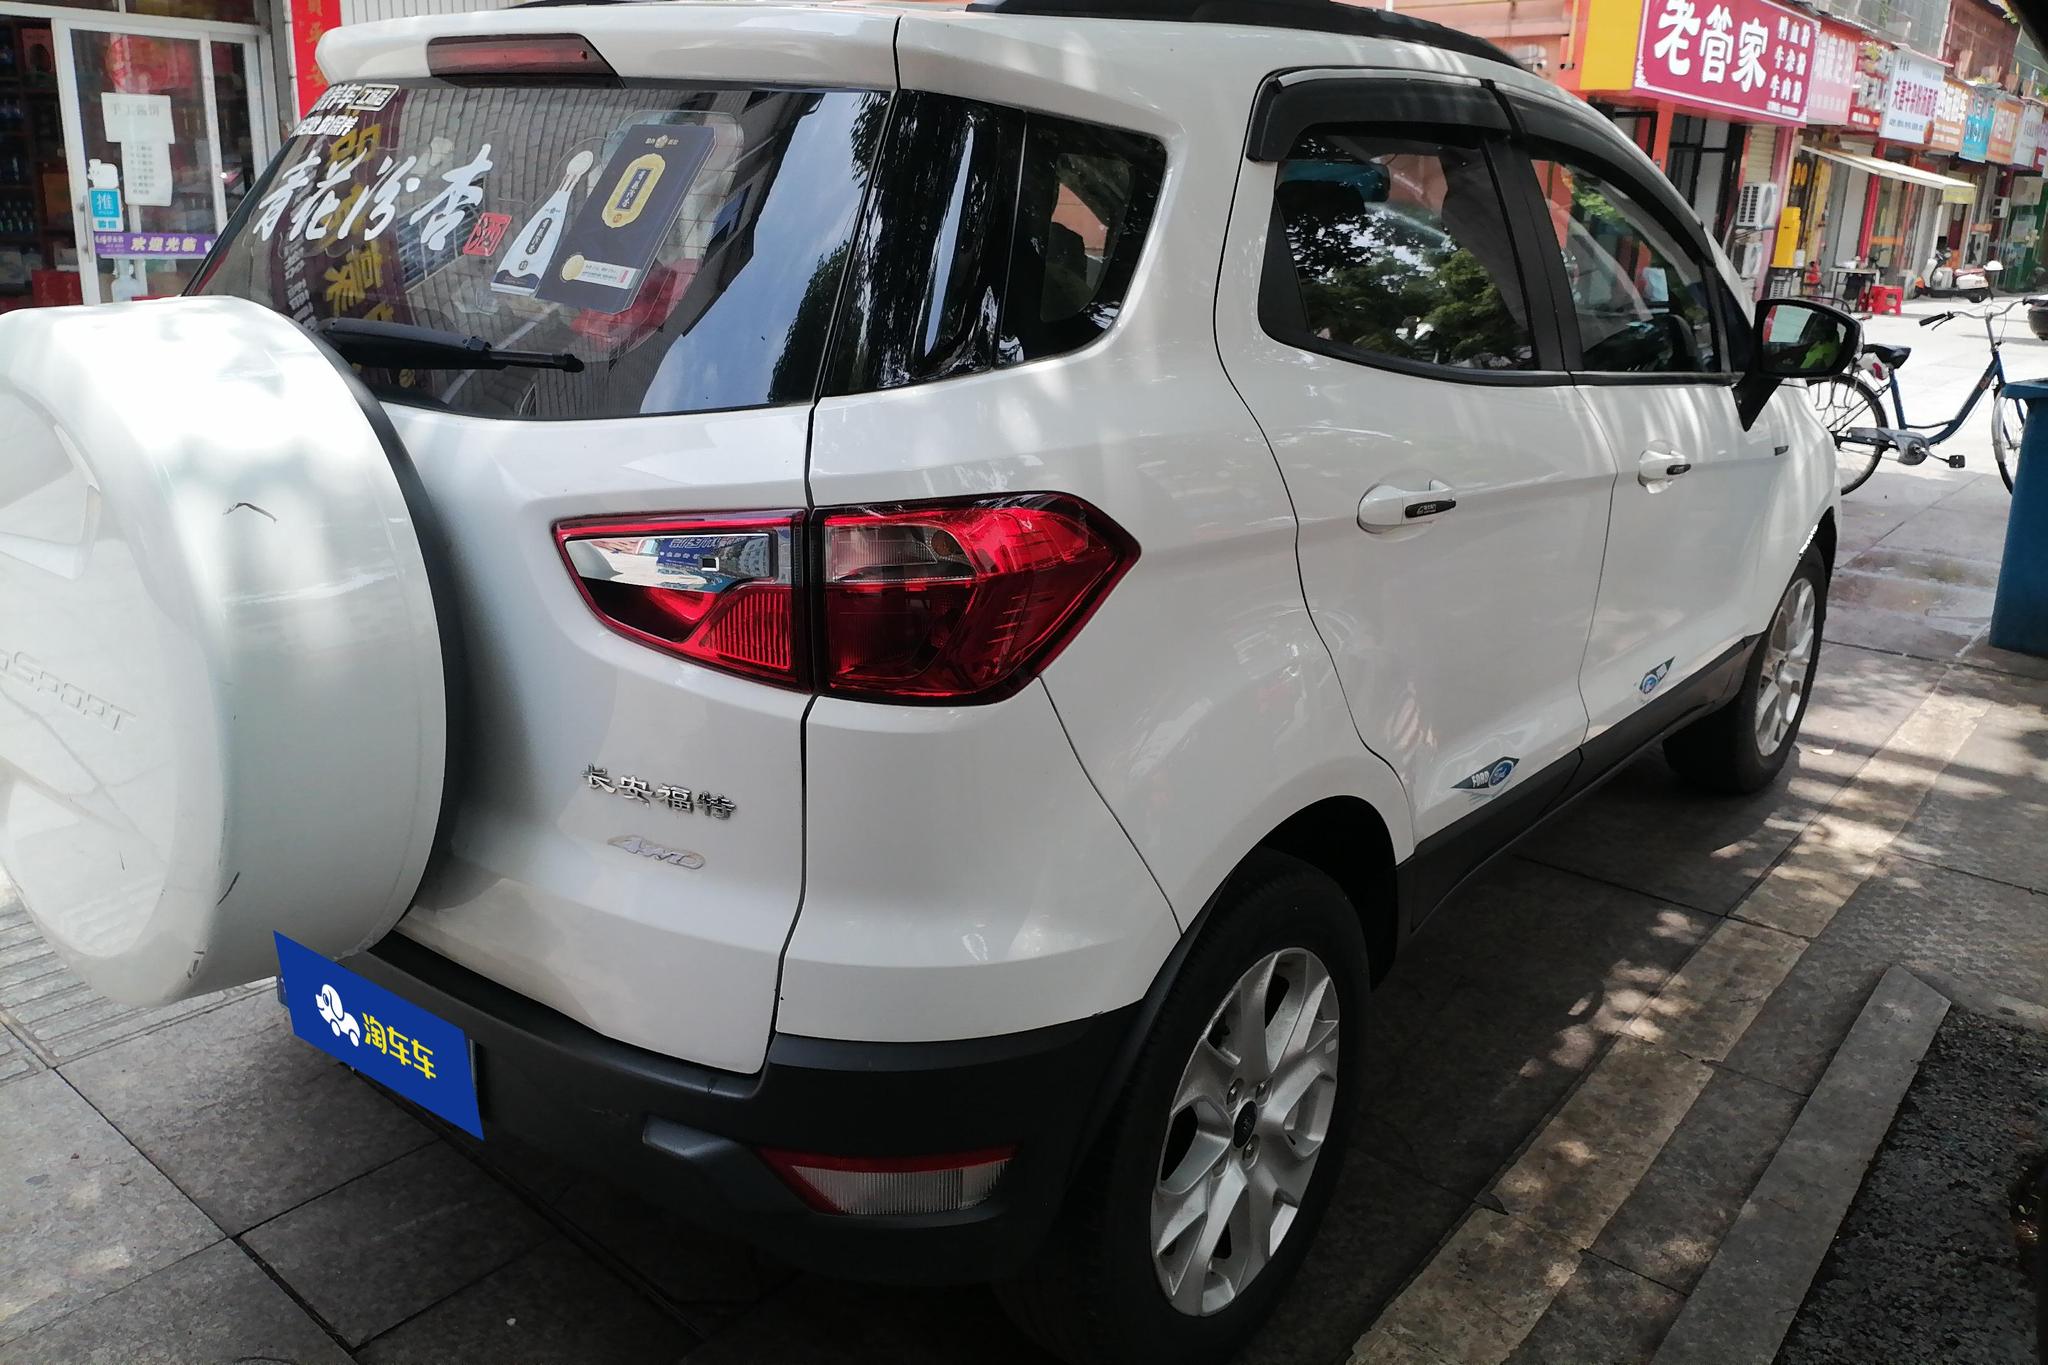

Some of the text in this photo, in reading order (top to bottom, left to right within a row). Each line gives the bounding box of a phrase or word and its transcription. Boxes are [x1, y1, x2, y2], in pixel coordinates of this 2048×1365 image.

[1654, 0, 1769, 93] 老管家
[96, 192, 113, 210] 推
[131, 236, 198, 252] 欢迎光临
[1471, 770, 1490, 788] FORD
[581, 762, 737, 820] 长安福特
